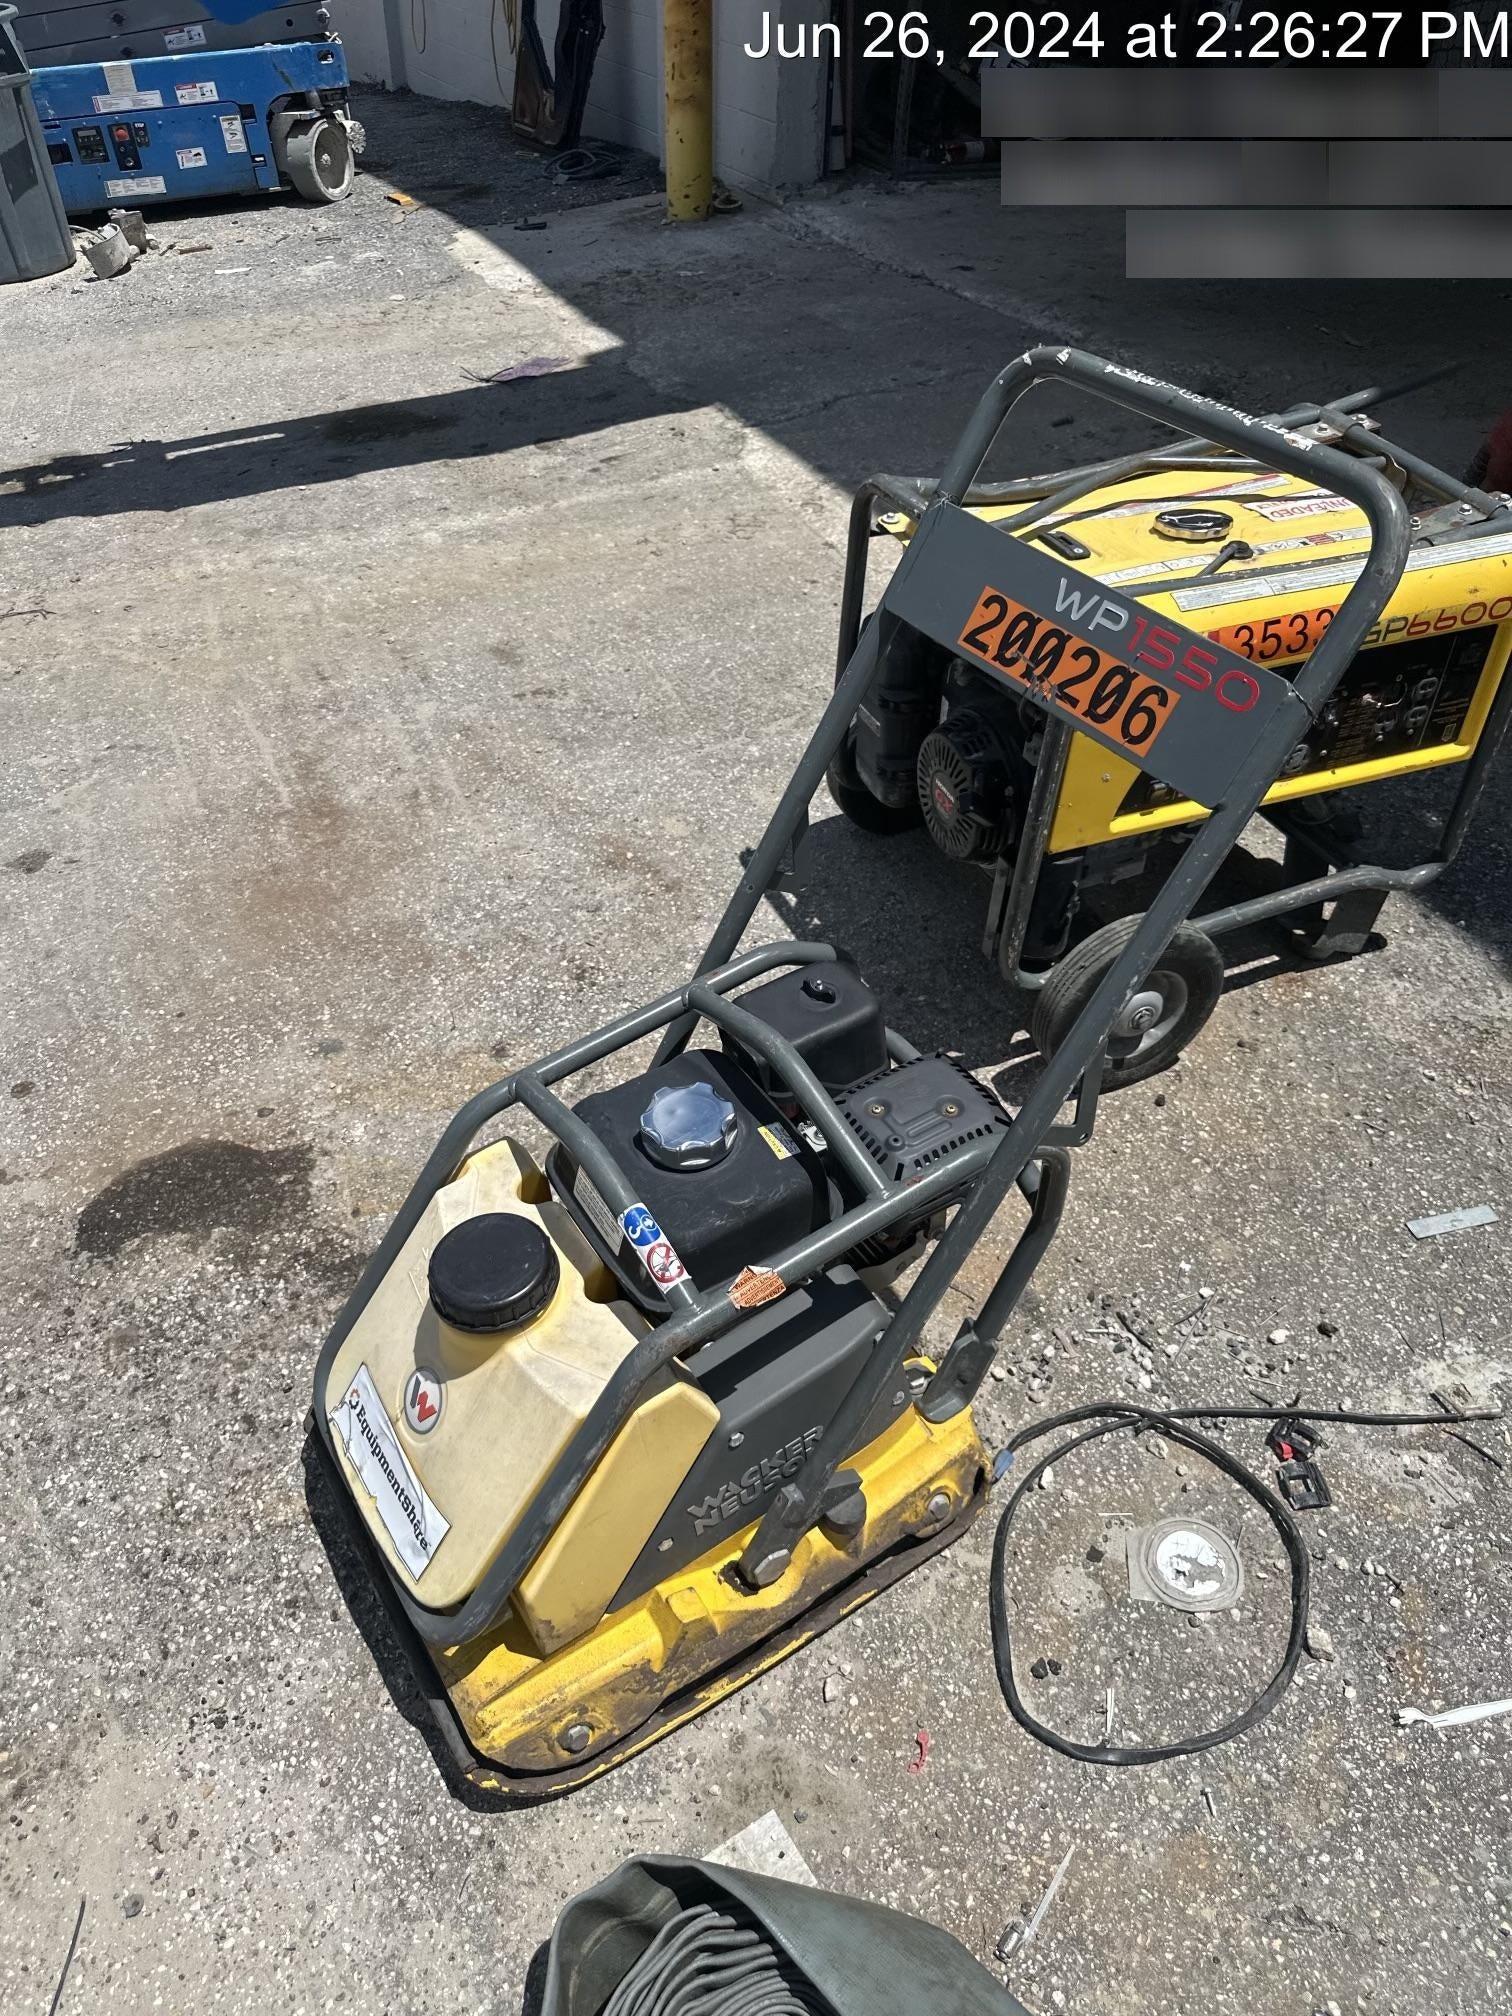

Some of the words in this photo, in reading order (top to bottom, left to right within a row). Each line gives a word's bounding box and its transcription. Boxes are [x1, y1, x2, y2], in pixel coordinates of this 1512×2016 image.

[963, 594, 1168, 746] 200206
[1055, 576, 1261, 713] WP1550
[356, 1404, 430, 1550] EquipmentShare
[687, 1425, 824, 1518] WACKER
[694, 1455, 806, 1537] NEUSO
